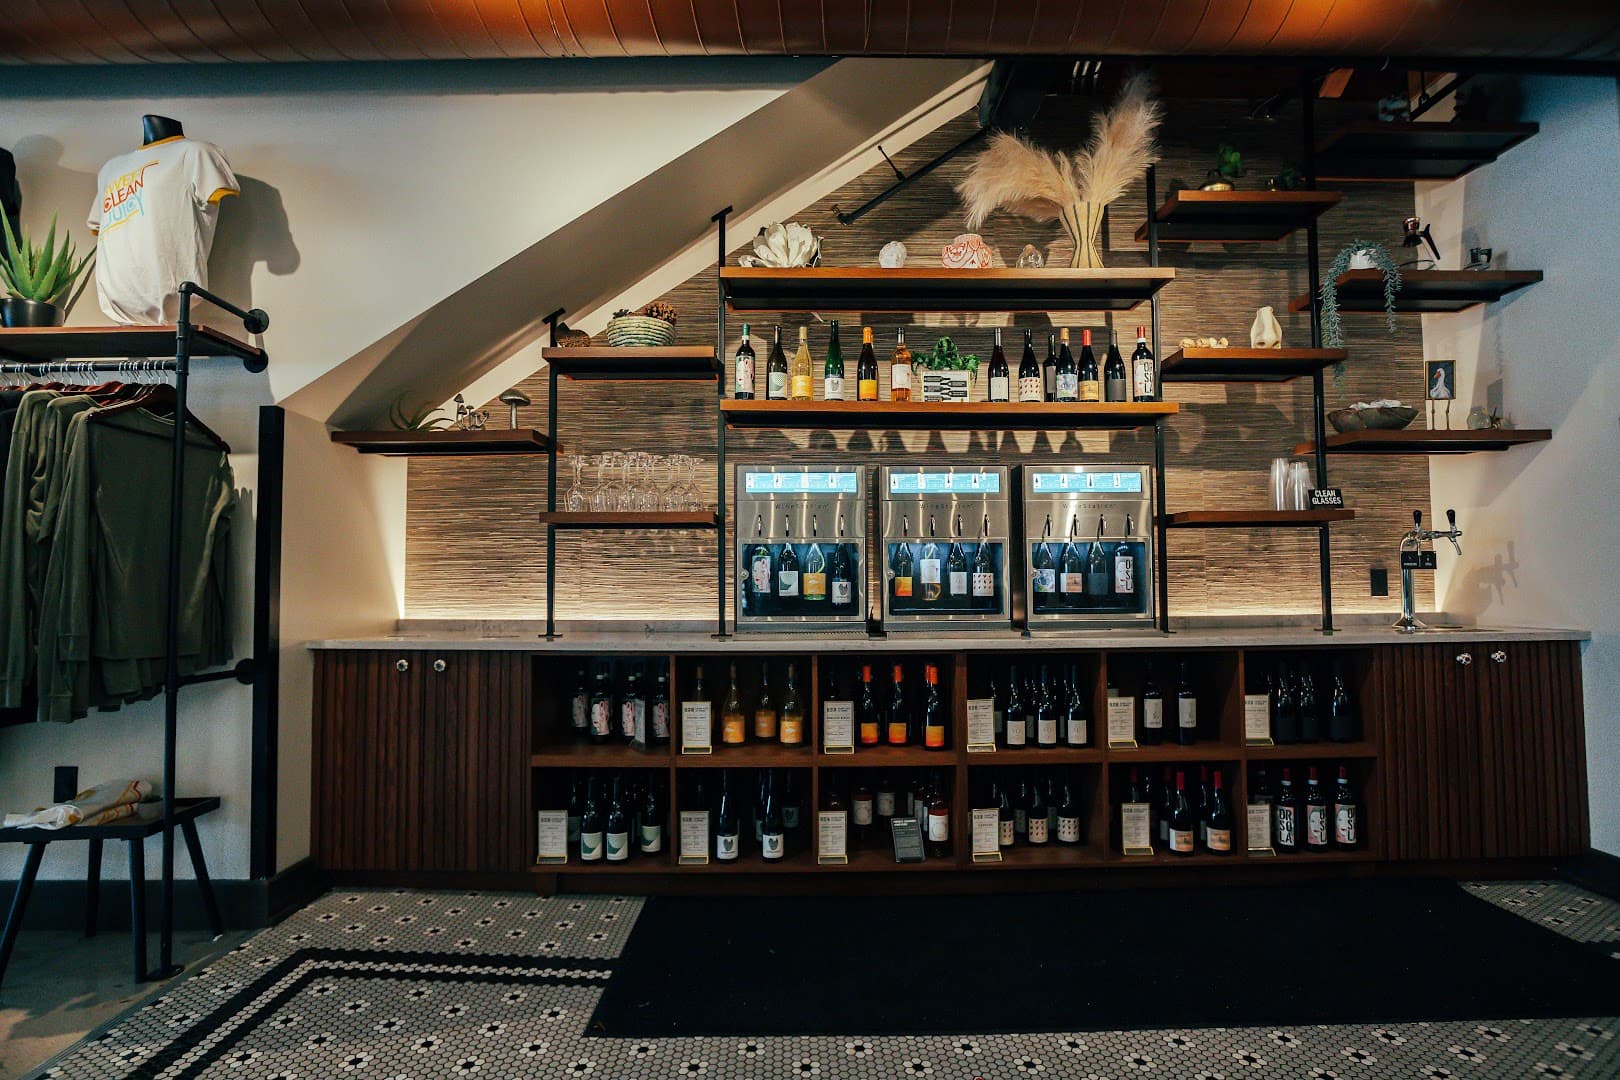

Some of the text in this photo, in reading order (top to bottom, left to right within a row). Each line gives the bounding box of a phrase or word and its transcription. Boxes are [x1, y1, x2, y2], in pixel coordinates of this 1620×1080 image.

[104, 164, 149, 213] CLEAN
[103, 189, 145, 228] JUICY
[1314, 489, 1336, 498] CLEAN
[1311, 496, 1342, 505] GLASSES
[1279, 808, 1293, 821] OR
[1279, 819, 1293, 832] SO
[1279, 831, 1293, 844] LA
